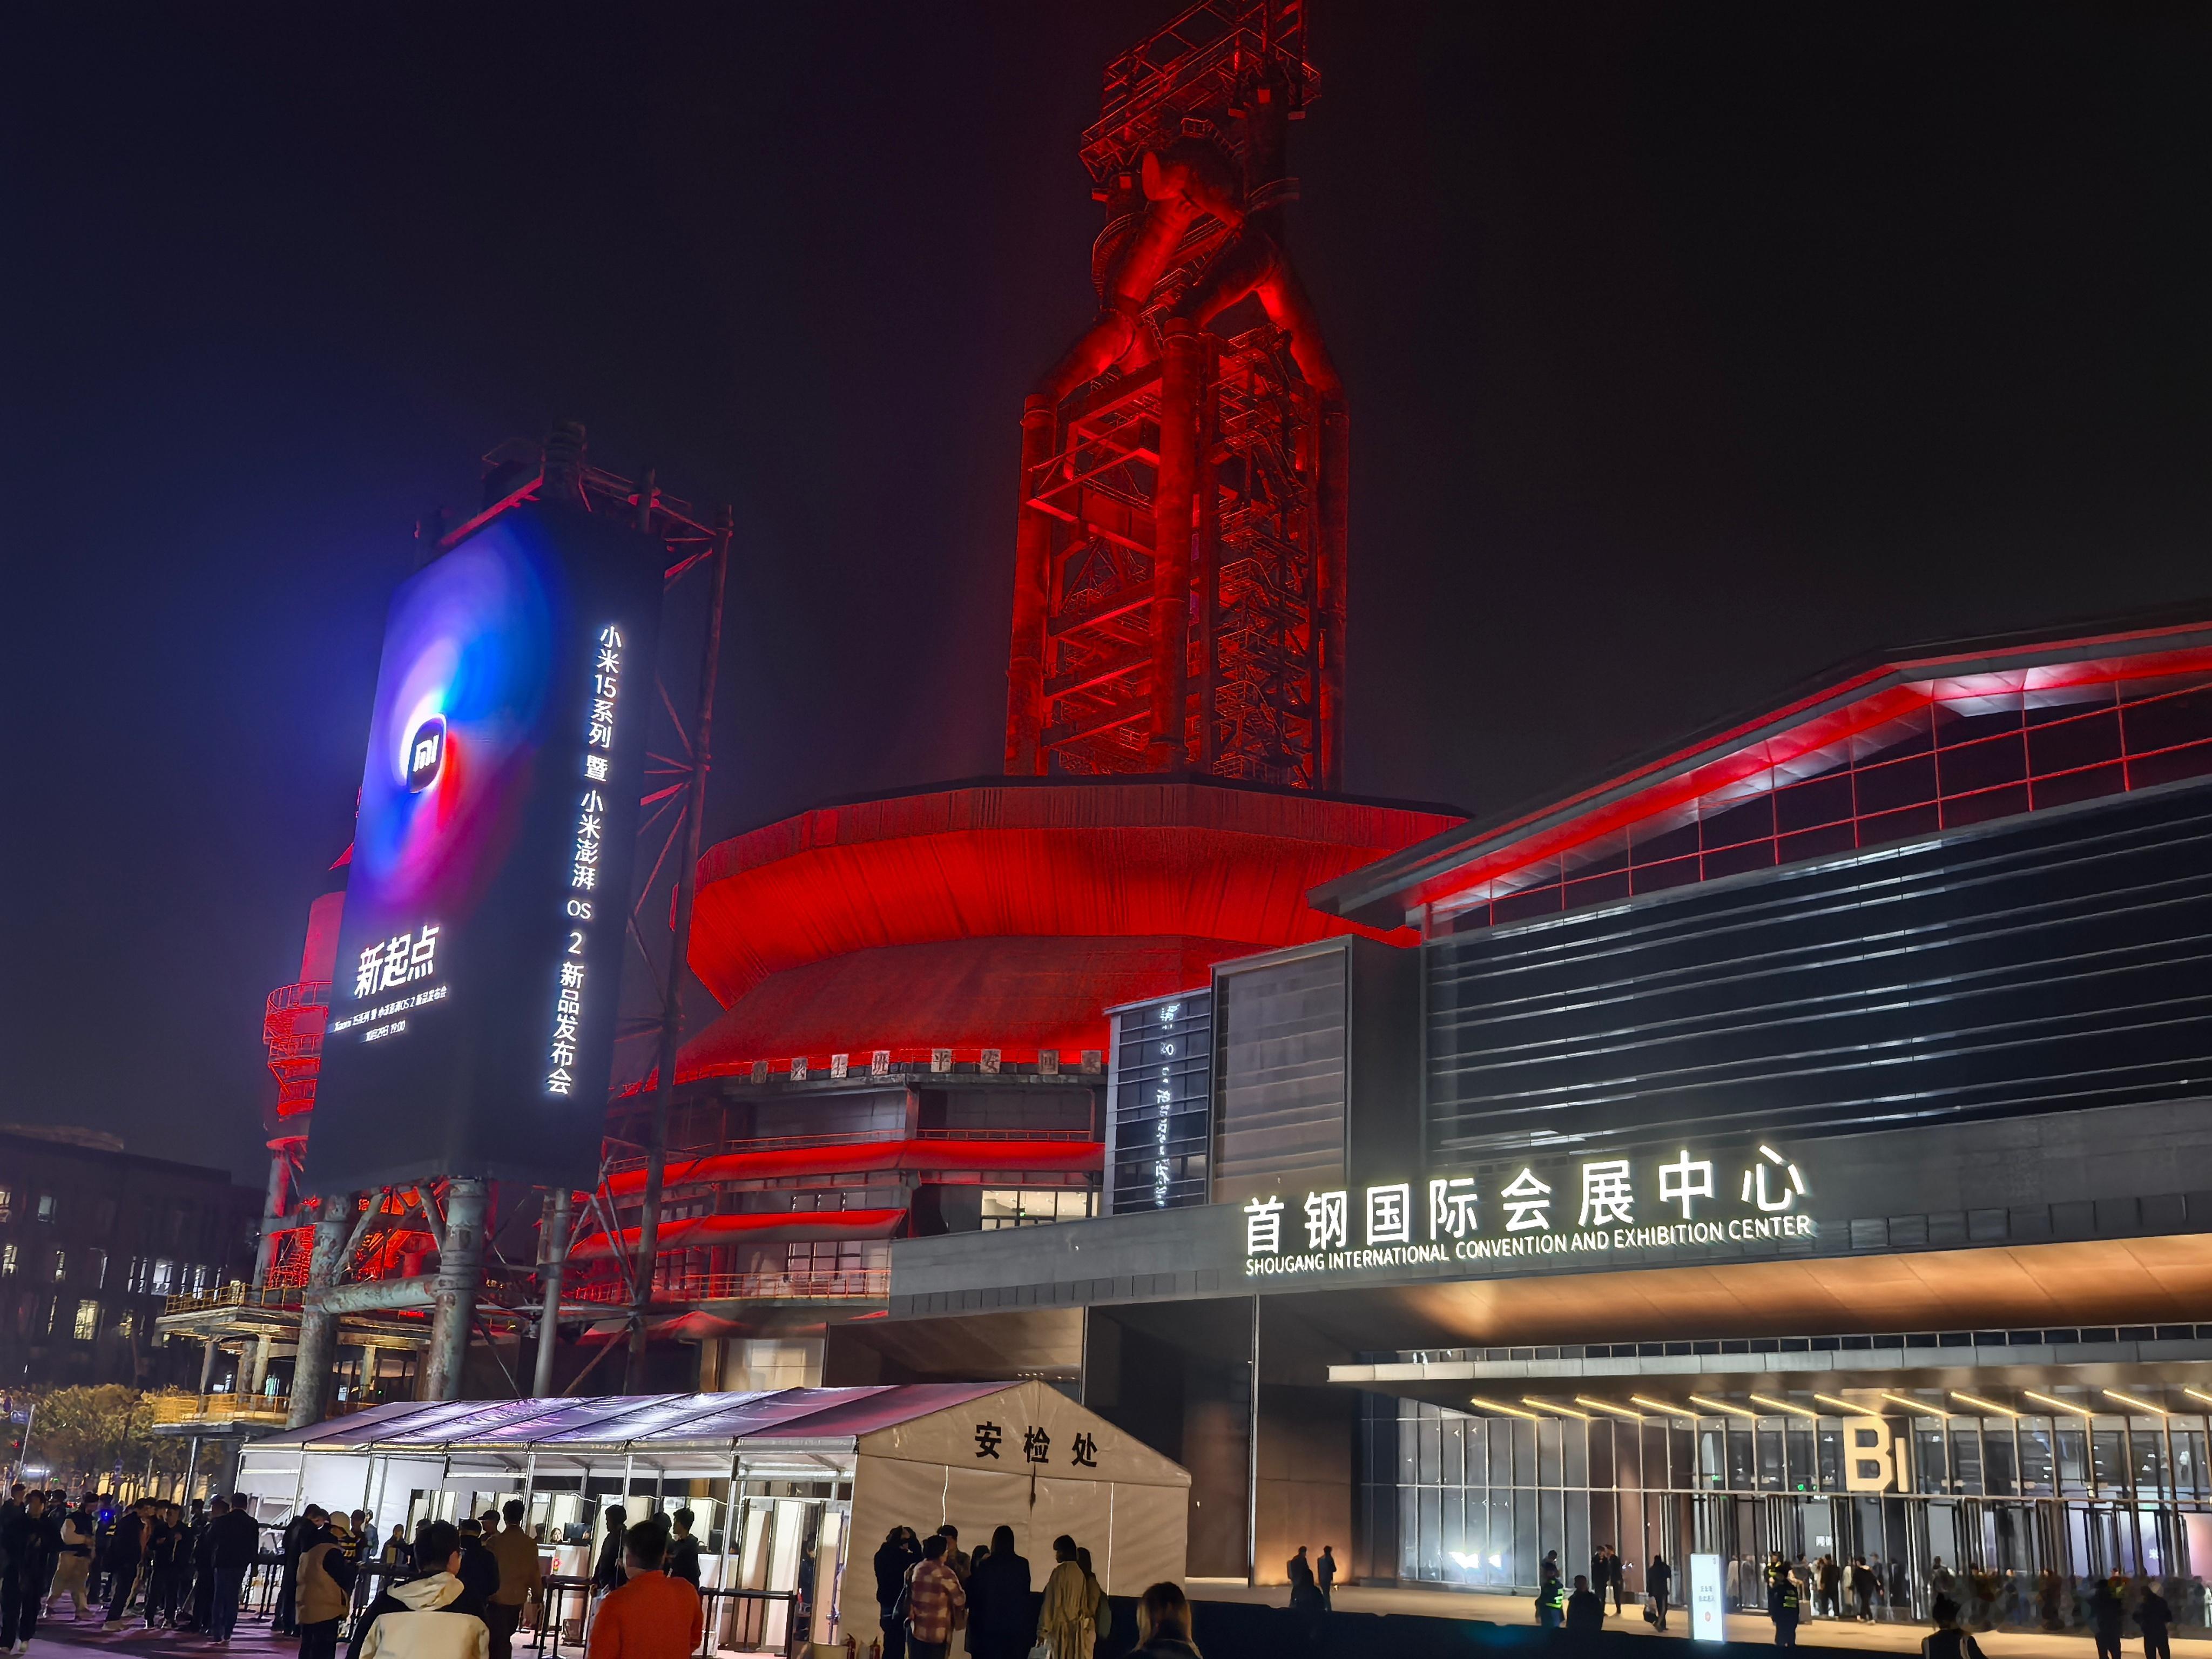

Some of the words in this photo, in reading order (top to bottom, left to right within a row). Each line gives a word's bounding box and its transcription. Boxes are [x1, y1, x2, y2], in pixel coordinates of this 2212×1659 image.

[589, 625, 622, 748] 小米15系列
[584, 754, 608, 782] 暨
[572, 790, 603, 890] 小米澎湃
[567, 900, 591, 919] OS
[568, 932, 583, 954] 2
[354, 925, 439, 999] 新起点
[548, 961, 584, 1095] 新品发布会
[1244, 1145, 1805, 1256] 首钢国际会展中心
[1246, 1252, 1325, 1276] SHOUGANG
[1328, 1244, 1449, 1270] INTERNATIONAL
[1455, 1233, 1567, 1259] CONVENTION
[1570, 1231, 1609, 1252] AND
[1614, 1222, 1725, 1249] EXHIBITION
[1728, 1215, 1812, 1240] CENTER
[974, 1421, 1098, 1468] 安检处
